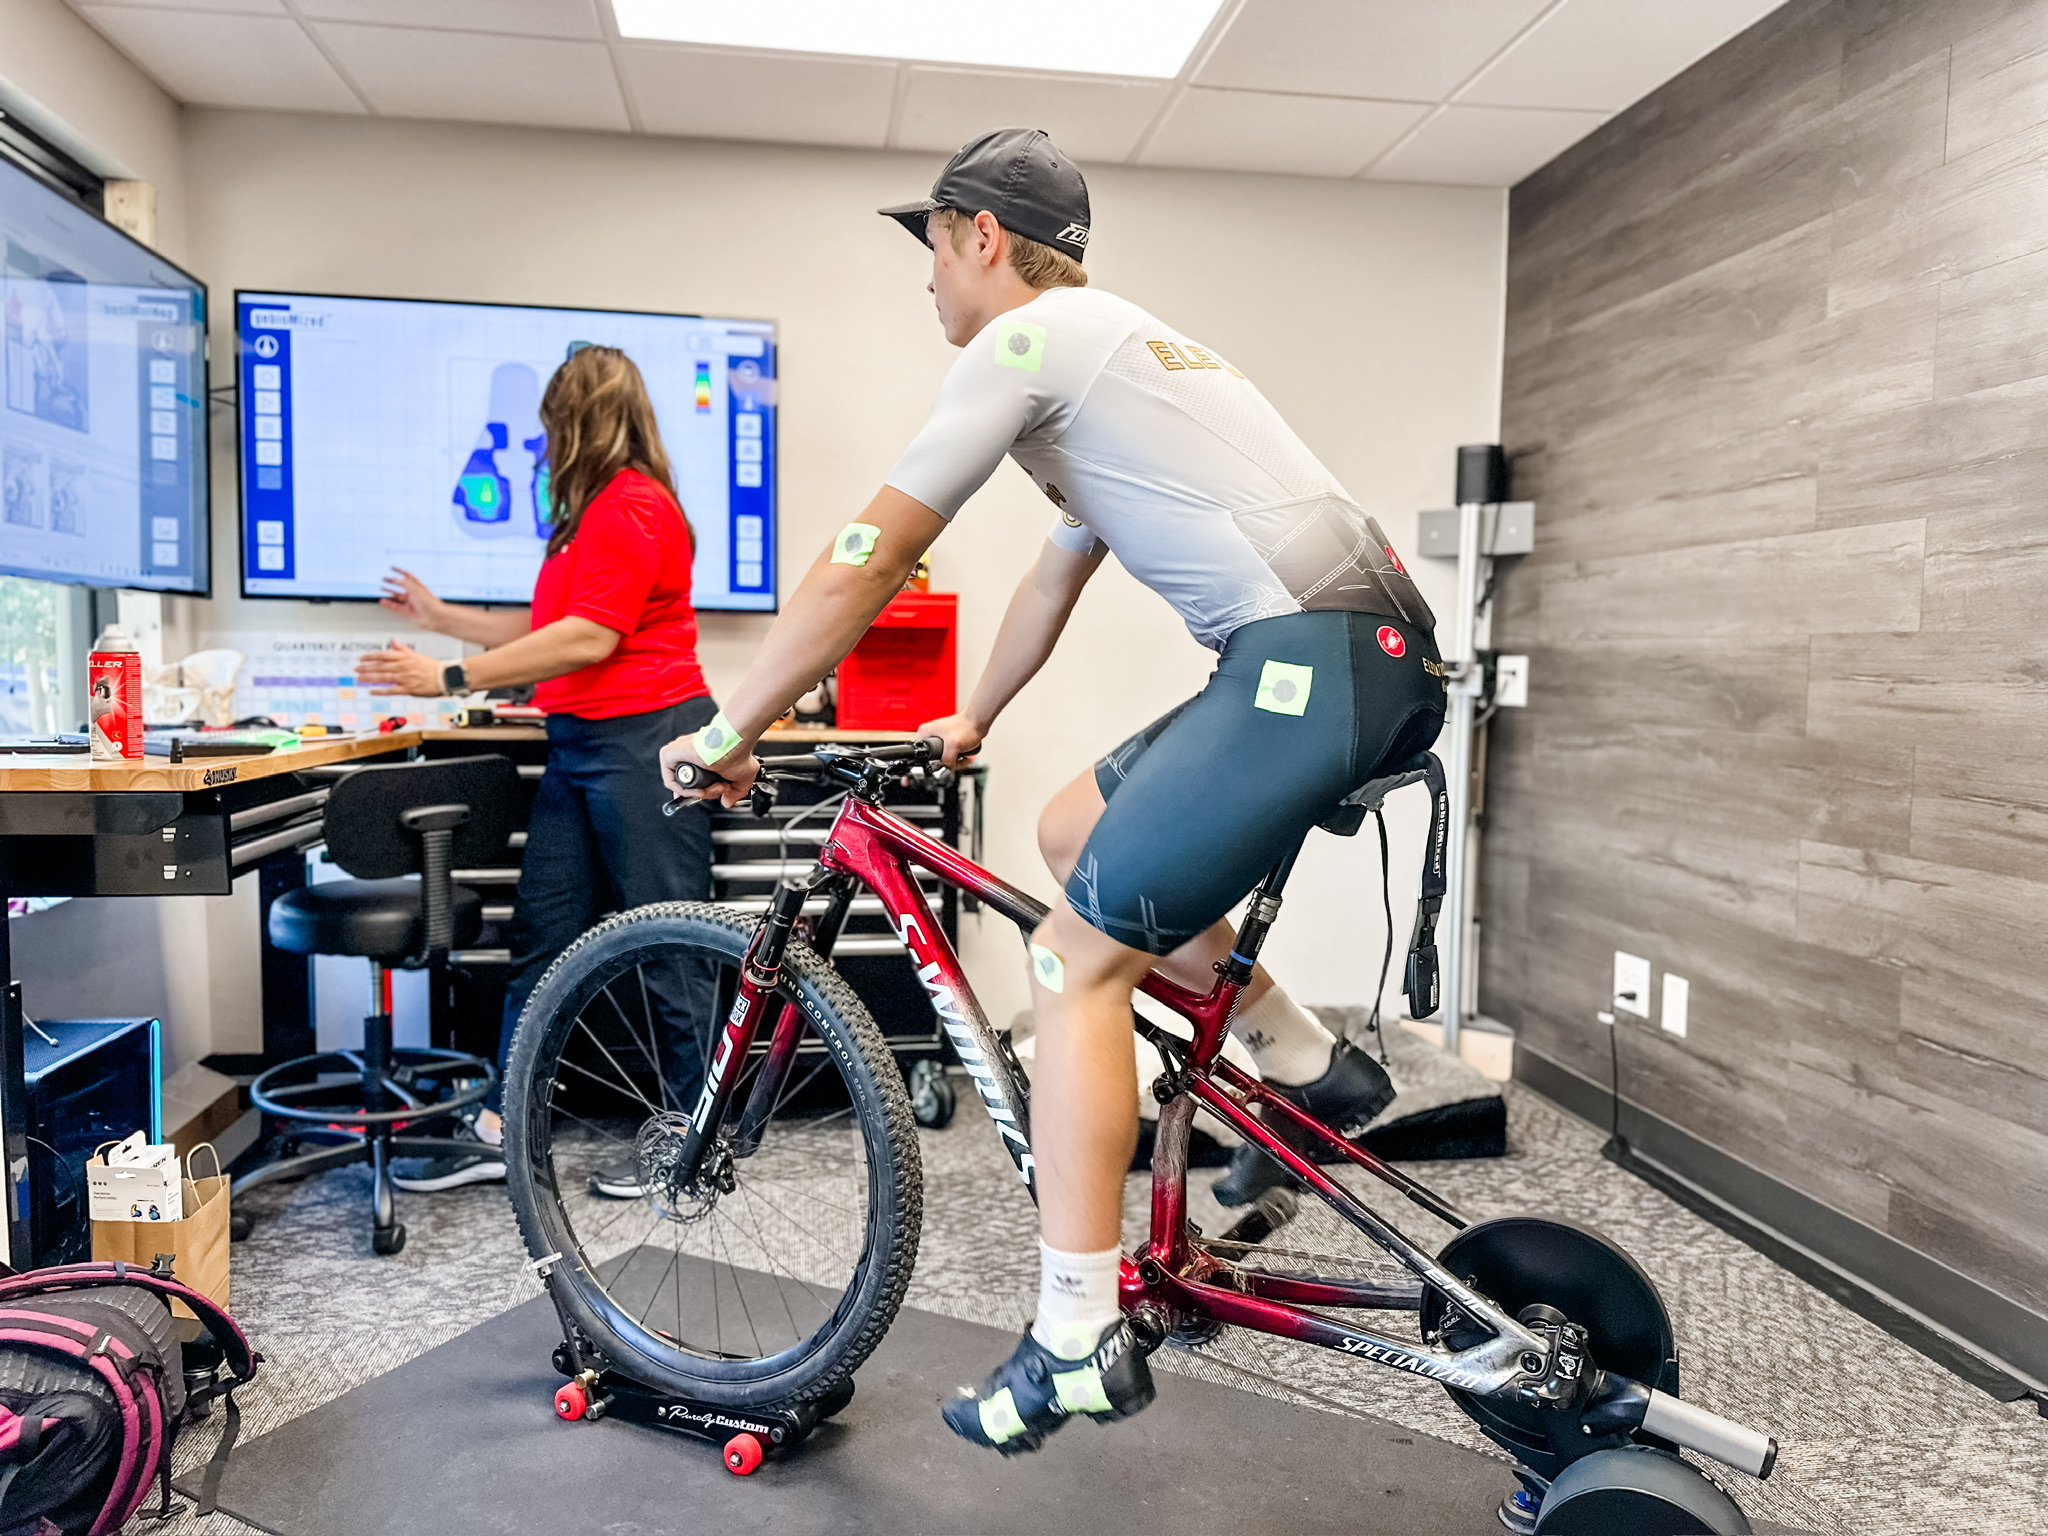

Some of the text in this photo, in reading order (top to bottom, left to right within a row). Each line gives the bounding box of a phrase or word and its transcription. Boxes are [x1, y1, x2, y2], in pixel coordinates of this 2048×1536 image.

[341, 642, 383, 651] ACTION
[213, 767, 238, 784] HUSKY
[806, 1000, 852, 1072] CONTROL
[1333, 1336, 1480, 1389] SPECIALIZED
[715, 1415, 770, 1434] Custom
